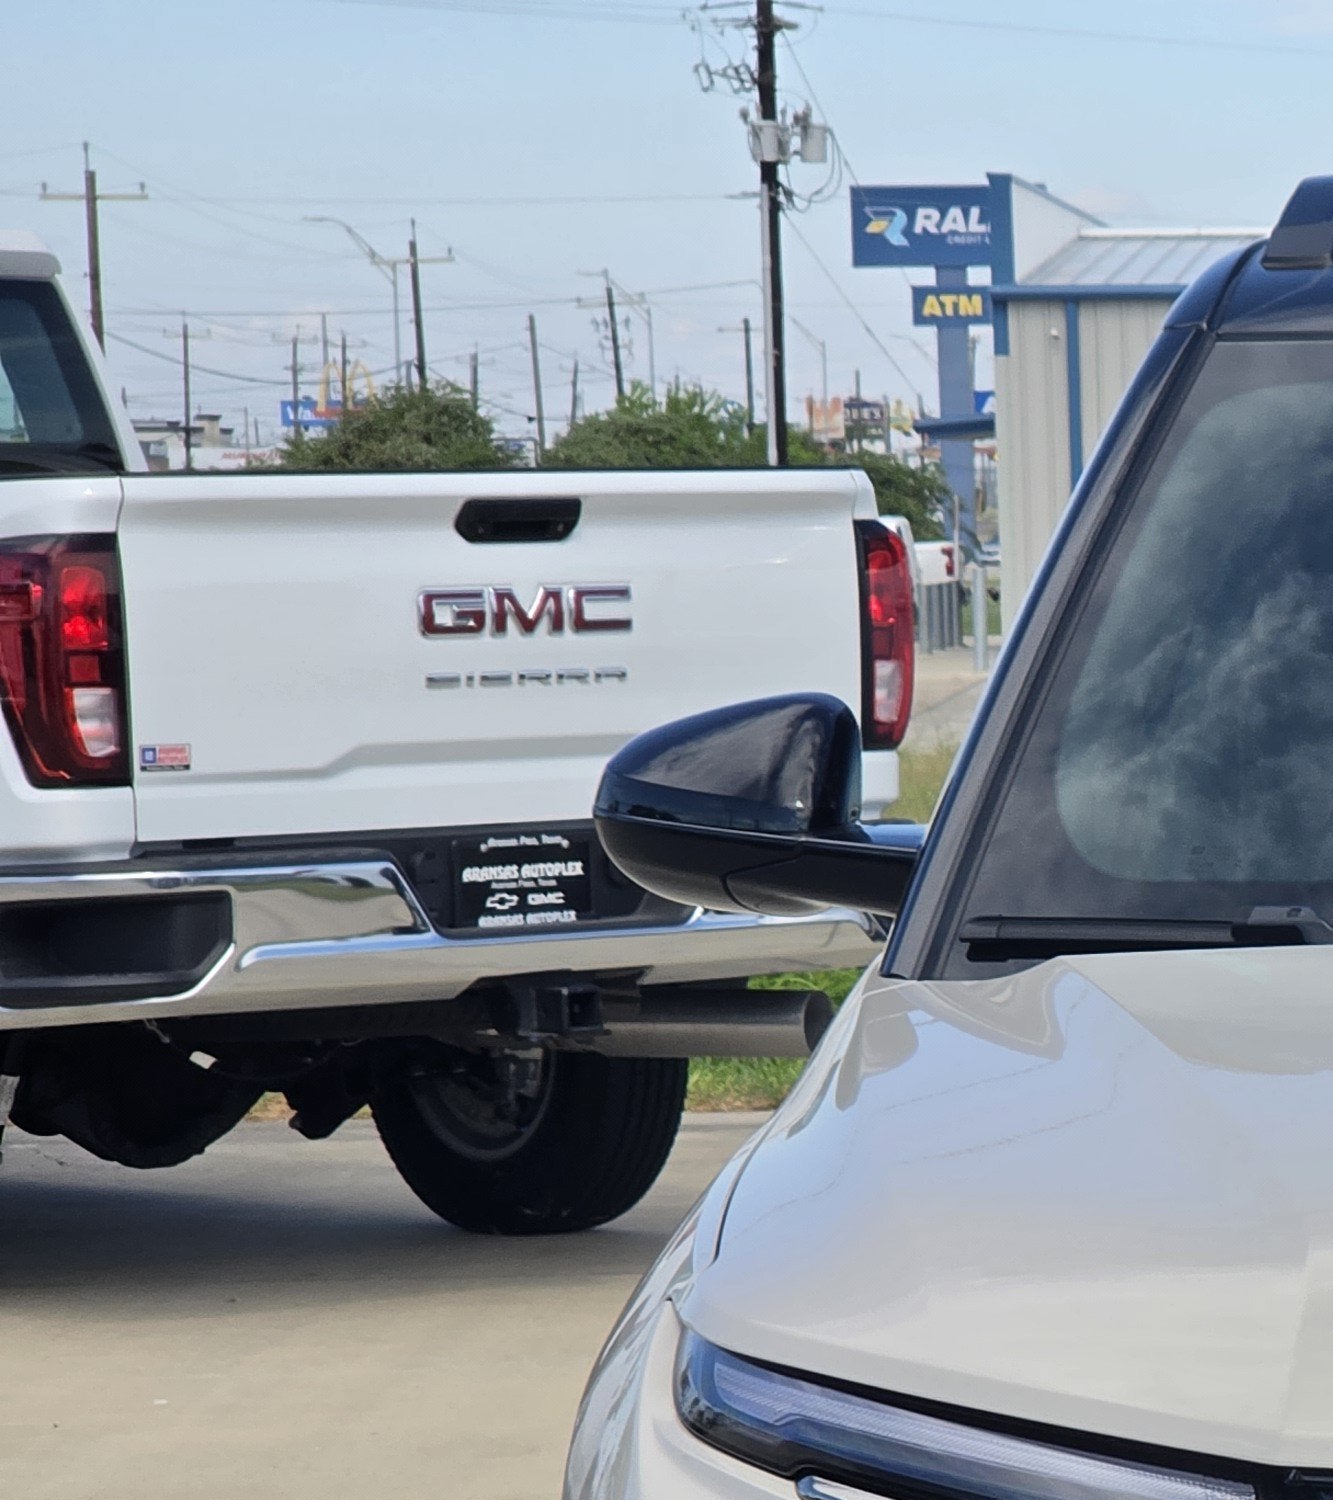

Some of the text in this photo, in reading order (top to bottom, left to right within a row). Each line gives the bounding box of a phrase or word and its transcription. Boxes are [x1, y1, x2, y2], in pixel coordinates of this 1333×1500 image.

[914, 206, 991, 234] RAL
[923, 294, 983, 316] ATM
[417, 583, 633, 638] GMC
[425, 666, 629, 688] SIERRA
[462, 861, 585, 883] ARANSAS AUTOPLEX
[527, 891, 565, 905] GMC
